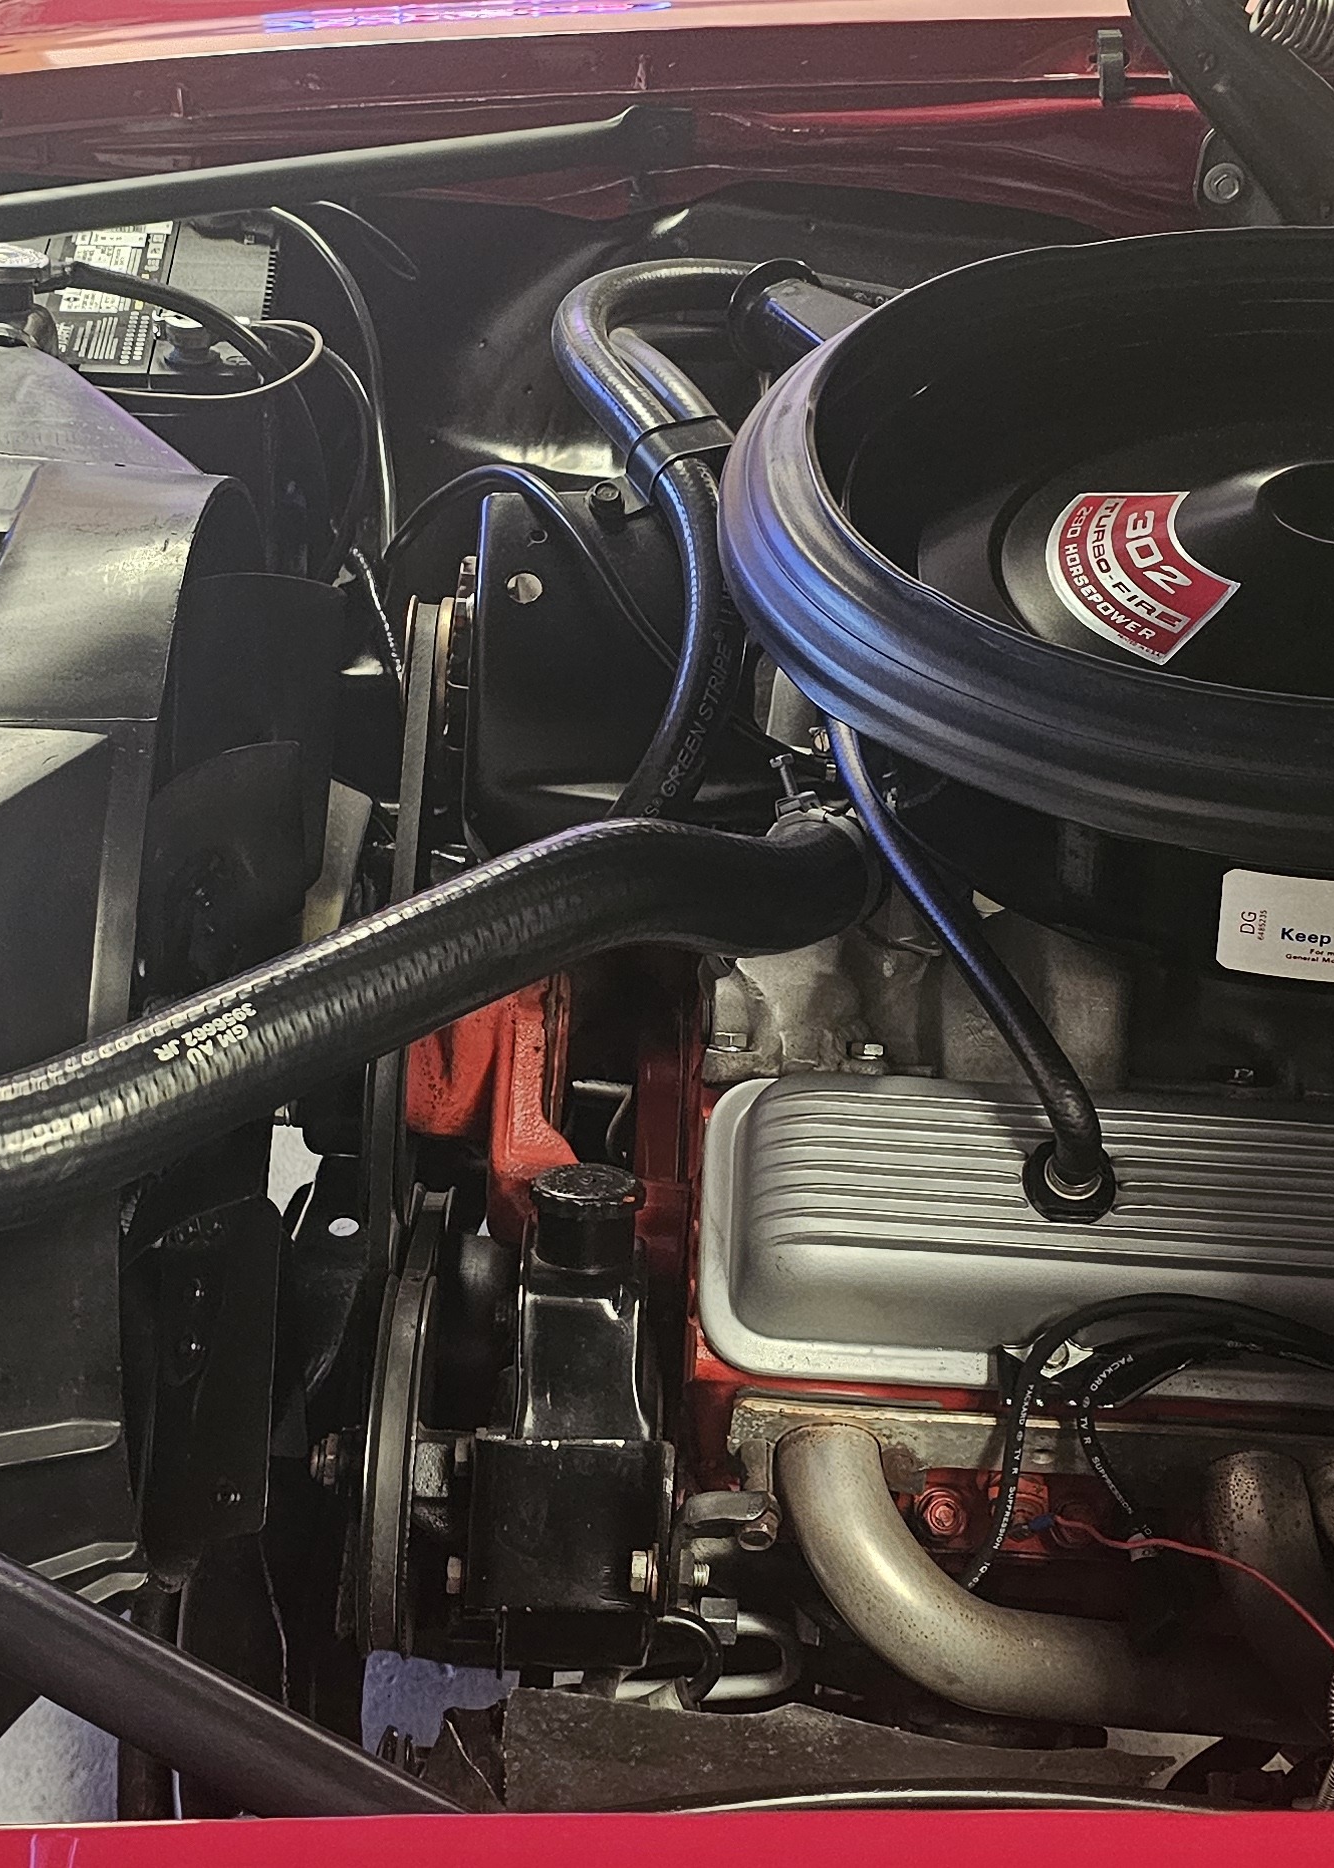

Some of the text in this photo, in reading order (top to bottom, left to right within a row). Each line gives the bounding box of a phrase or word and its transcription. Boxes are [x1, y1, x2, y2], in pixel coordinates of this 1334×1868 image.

[1066, 506, 1093, 539] 290
[1088, 502, 1185, 629] TURBO-FIRE
[1126, 510, 1192, 595] 302
[1064, 544, 1158, 641] HORSEPOWER
[661, 721, 707, 798] GREEN
[1240, 911, 1257, 935] DG
[1280, 927, 1332, 947] Keep
[1285, 953, 1319, 962] General
[153, 1002, 257, 1062] 3956662 JR
[187, 1023, 249, 1065] GM AU
[1090, 1353, 1134, 1392] PACKARD
[1019, 1384, 1034, 1426] PACKARD
[1083, 1436, 1092, 1445] R
[1012, 1467, 1018, 1475] R
[993, 1486, 1016, 1550] SUPPRESSION
